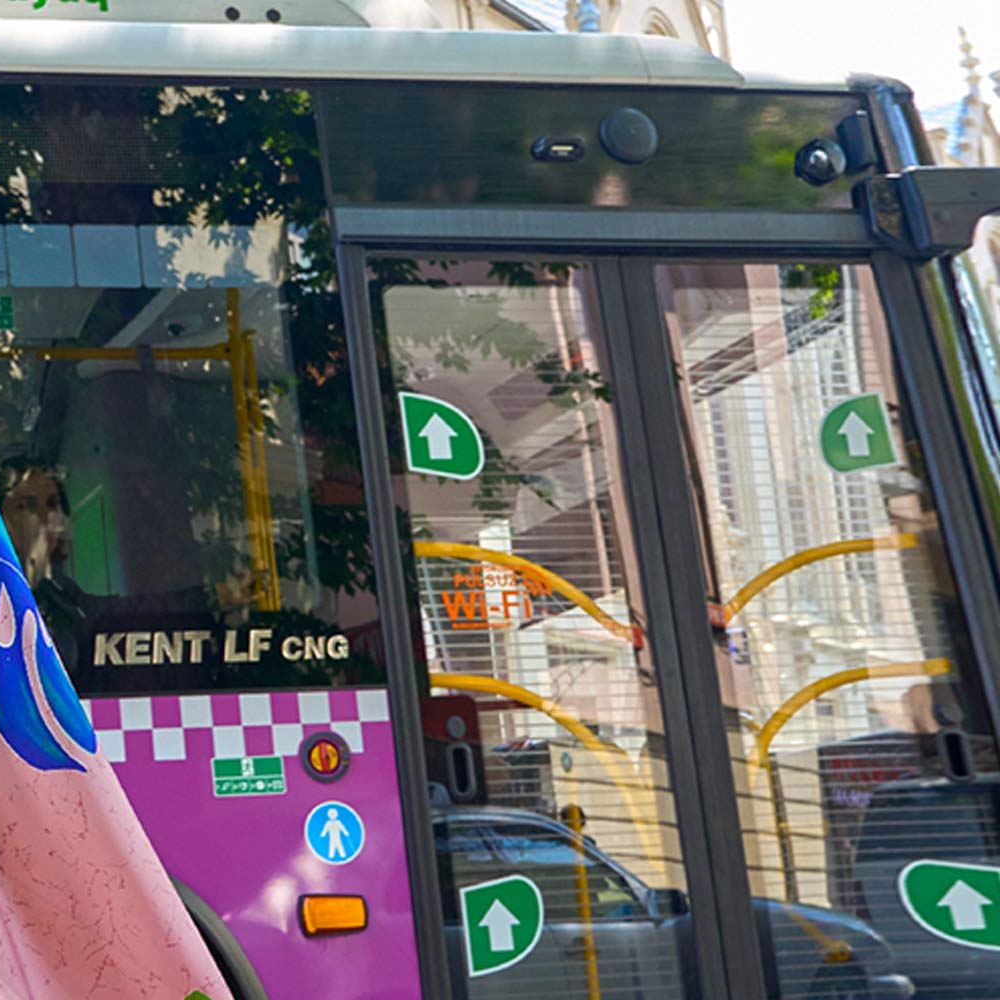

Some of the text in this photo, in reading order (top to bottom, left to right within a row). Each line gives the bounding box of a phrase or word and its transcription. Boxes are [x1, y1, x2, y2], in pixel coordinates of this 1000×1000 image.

[441, 590, 532, 620] Wi-Fi
[93, 628, 350, 666] KENT LF CNG
